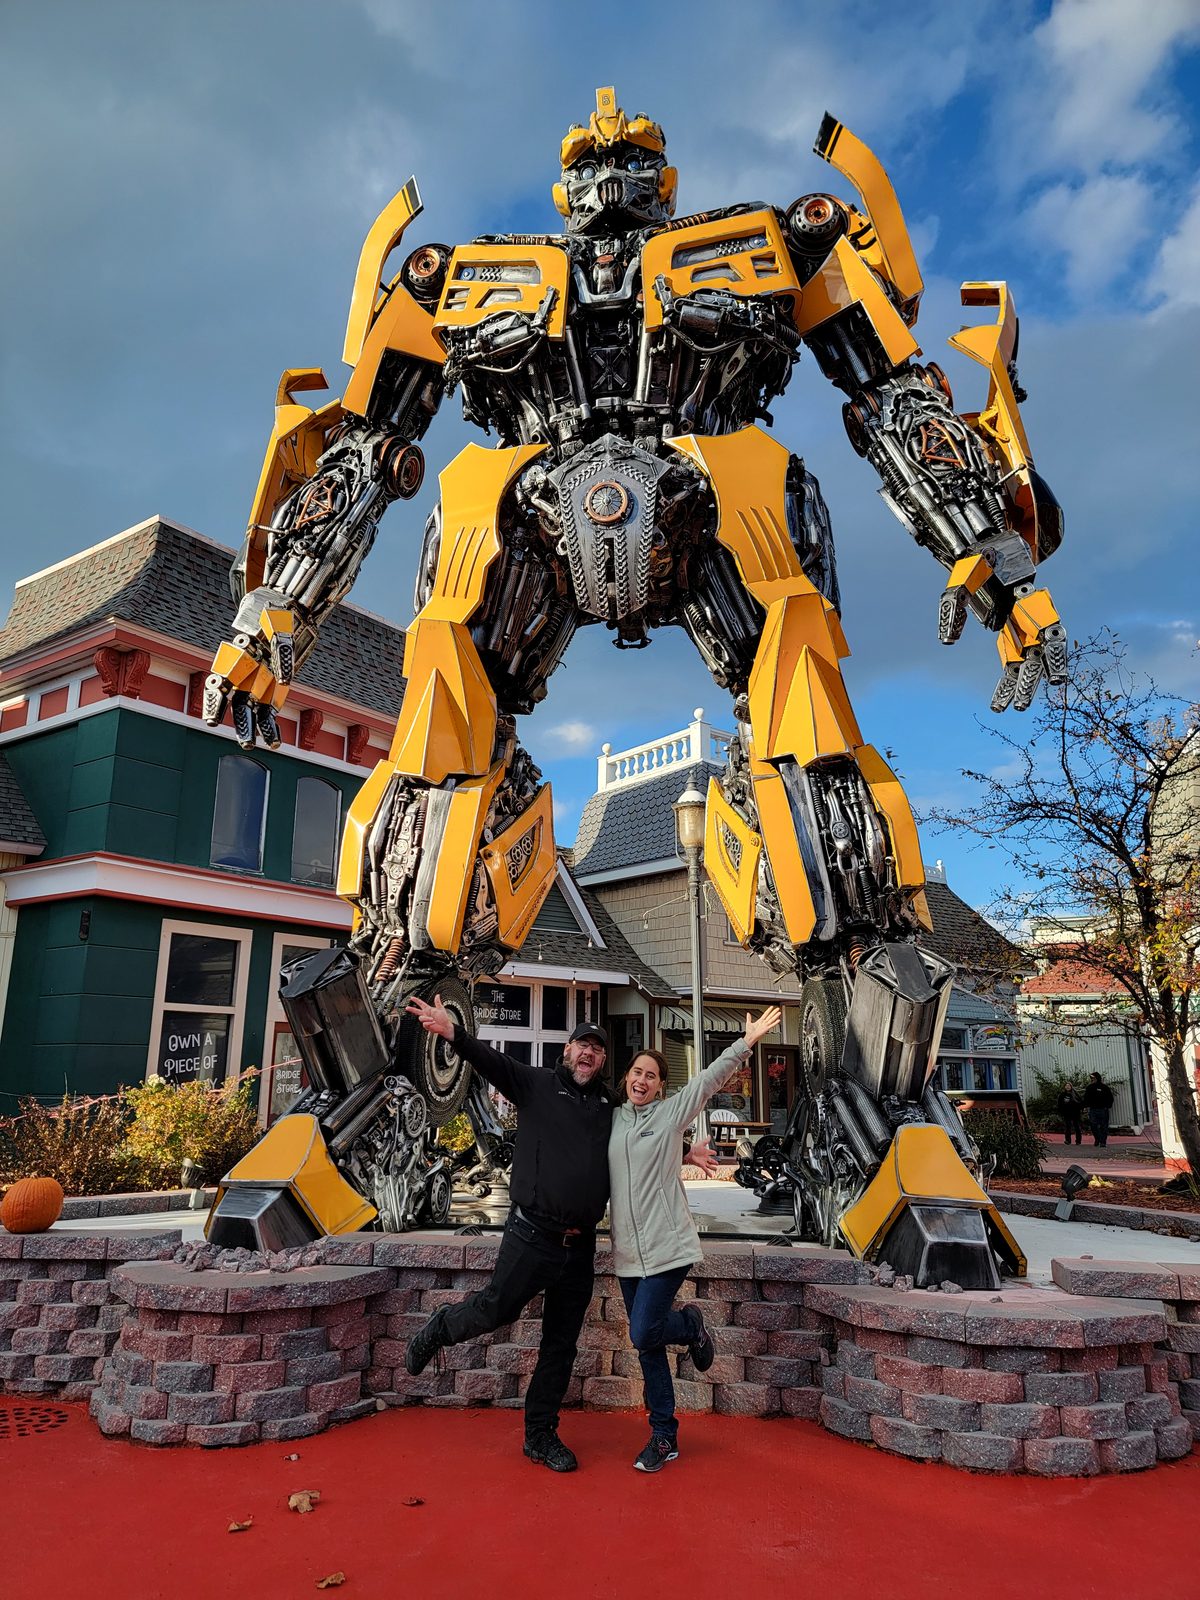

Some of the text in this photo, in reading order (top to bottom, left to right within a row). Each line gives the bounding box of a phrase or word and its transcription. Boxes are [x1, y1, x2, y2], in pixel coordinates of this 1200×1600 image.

[473, 1005, 522, 1021] BRIDGE STORE
[168, 1032, 213, 1052] OWN A
[164, 1054, 218, 1078] PIECE OF
[275, 1069, 301, 1080] BRIDGE
